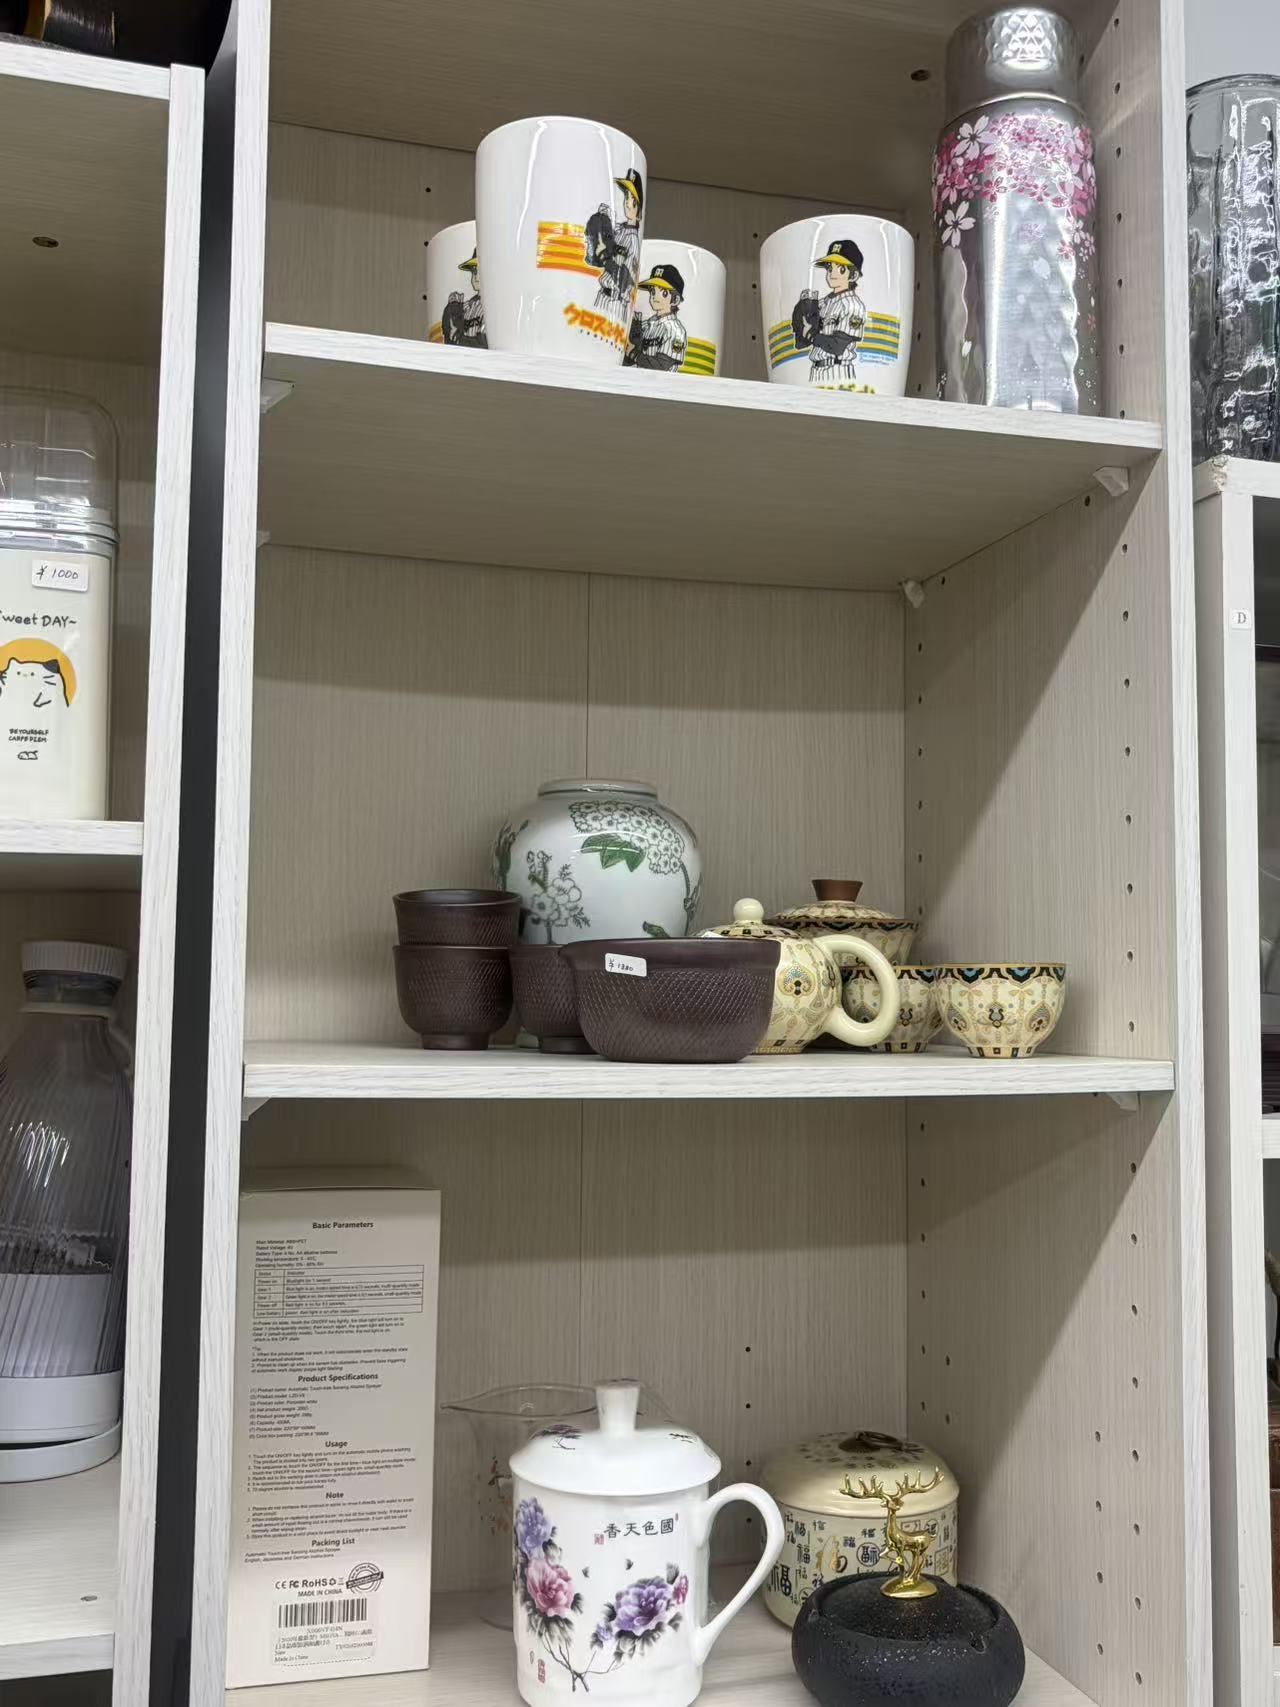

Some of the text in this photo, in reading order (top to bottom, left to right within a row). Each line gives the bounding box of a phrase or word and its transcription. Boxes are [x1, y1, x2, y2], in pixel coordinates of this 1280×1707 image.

[0, 609, 37, 625] weet
[1238, 612, 1246, 623] D
[328, 1373, 378, 1383] Specifications
[325, 1440, 348, 1448] Usage
[302, 1578, 327, 1588] RoHS
